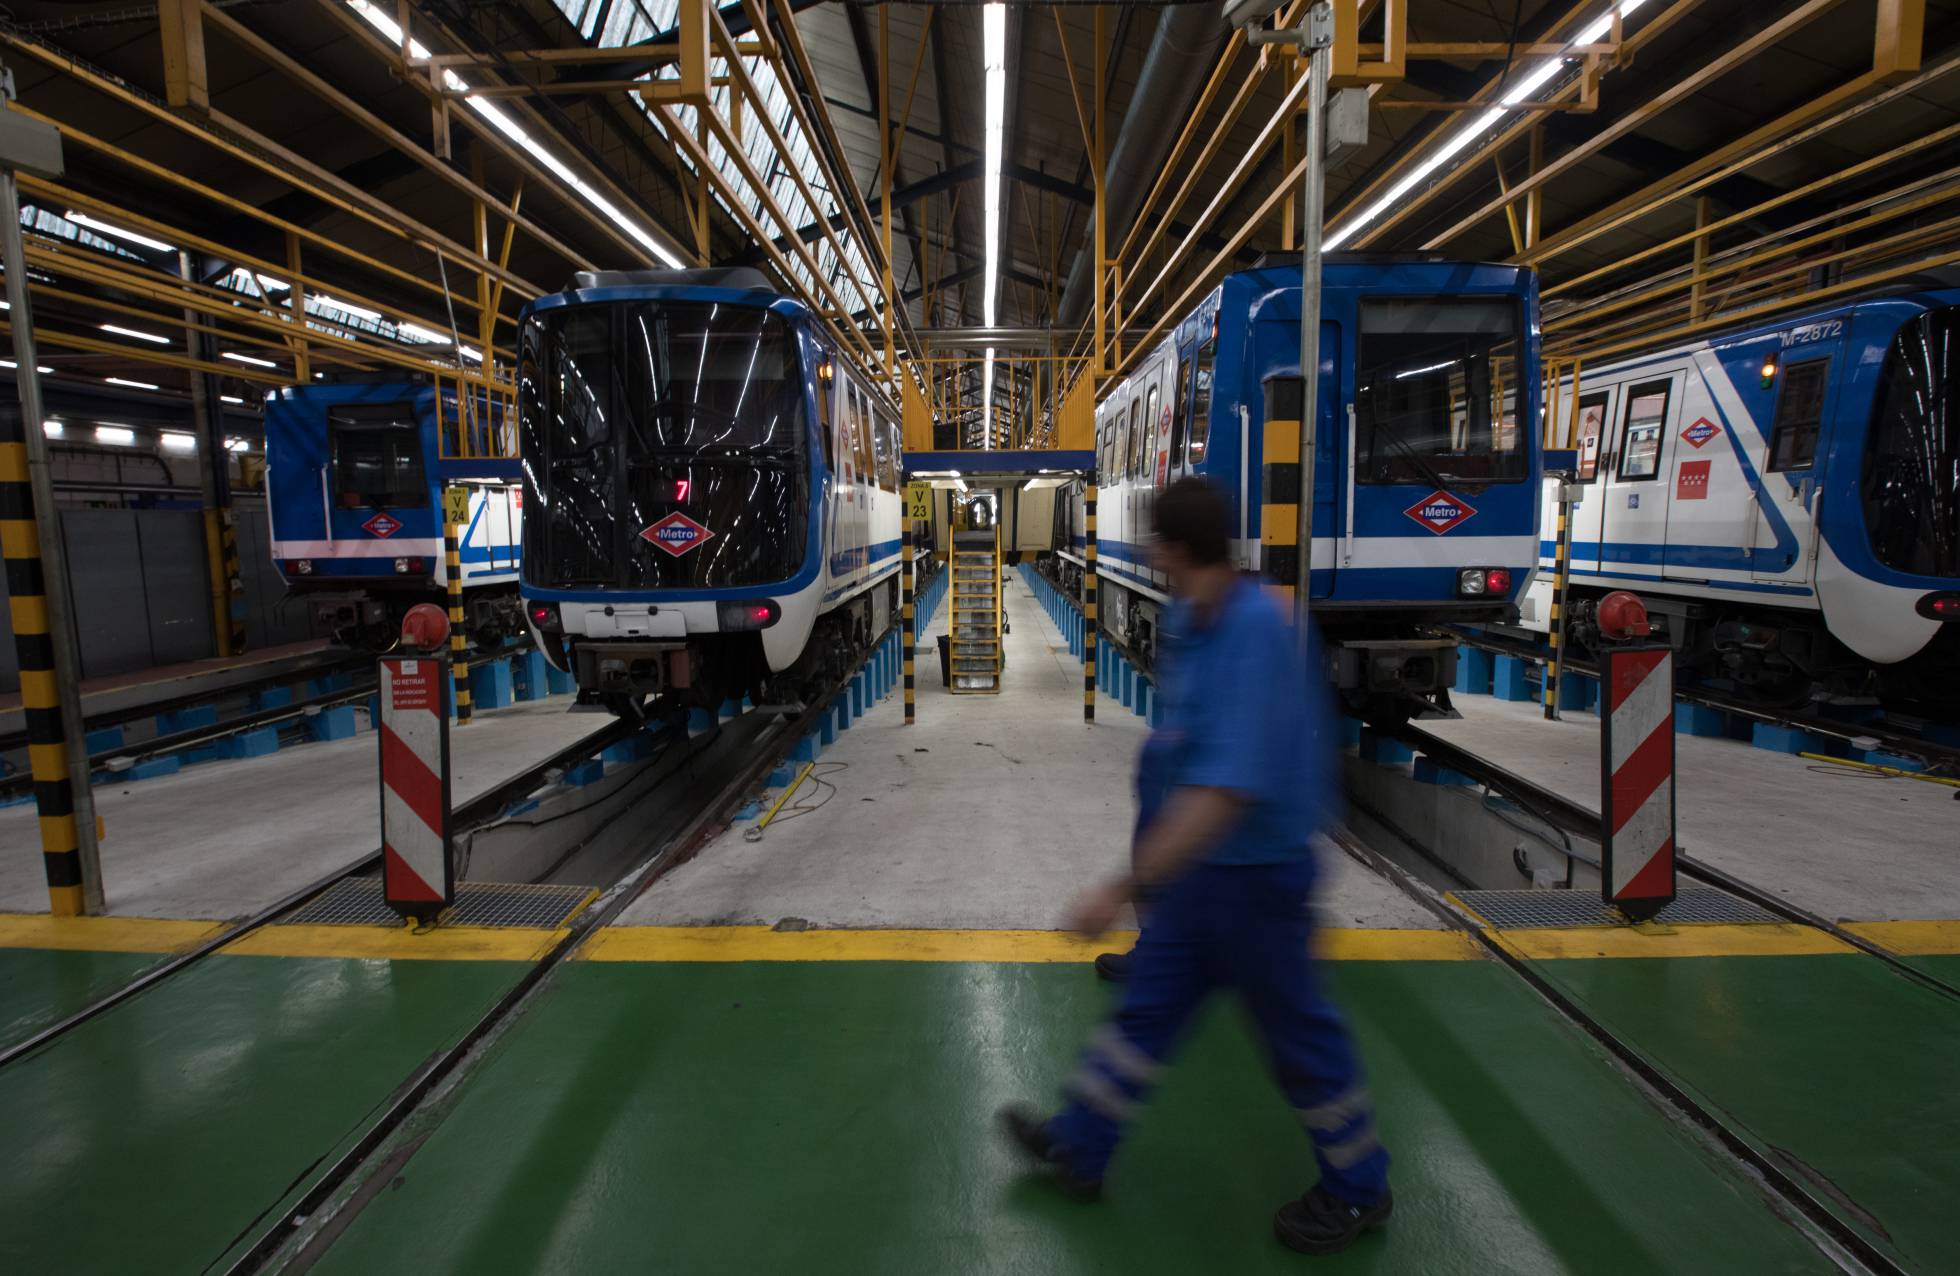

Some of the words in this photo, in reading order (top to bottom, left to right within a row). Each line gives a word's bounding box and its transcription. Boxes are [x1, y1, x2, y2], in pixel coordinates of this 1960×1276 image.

[1781, 321, 1841, 347] M-2872
[677, 480, 688, 501] 7
[453, 496, 461, 508] V
[915, 491, 924, 503] V
[451, 510, 465, 522] 24
[913, 505, 927, 517] 23
[1425, 506, 1456, 517] Metro
[660, 528, 693, 539] Metro
